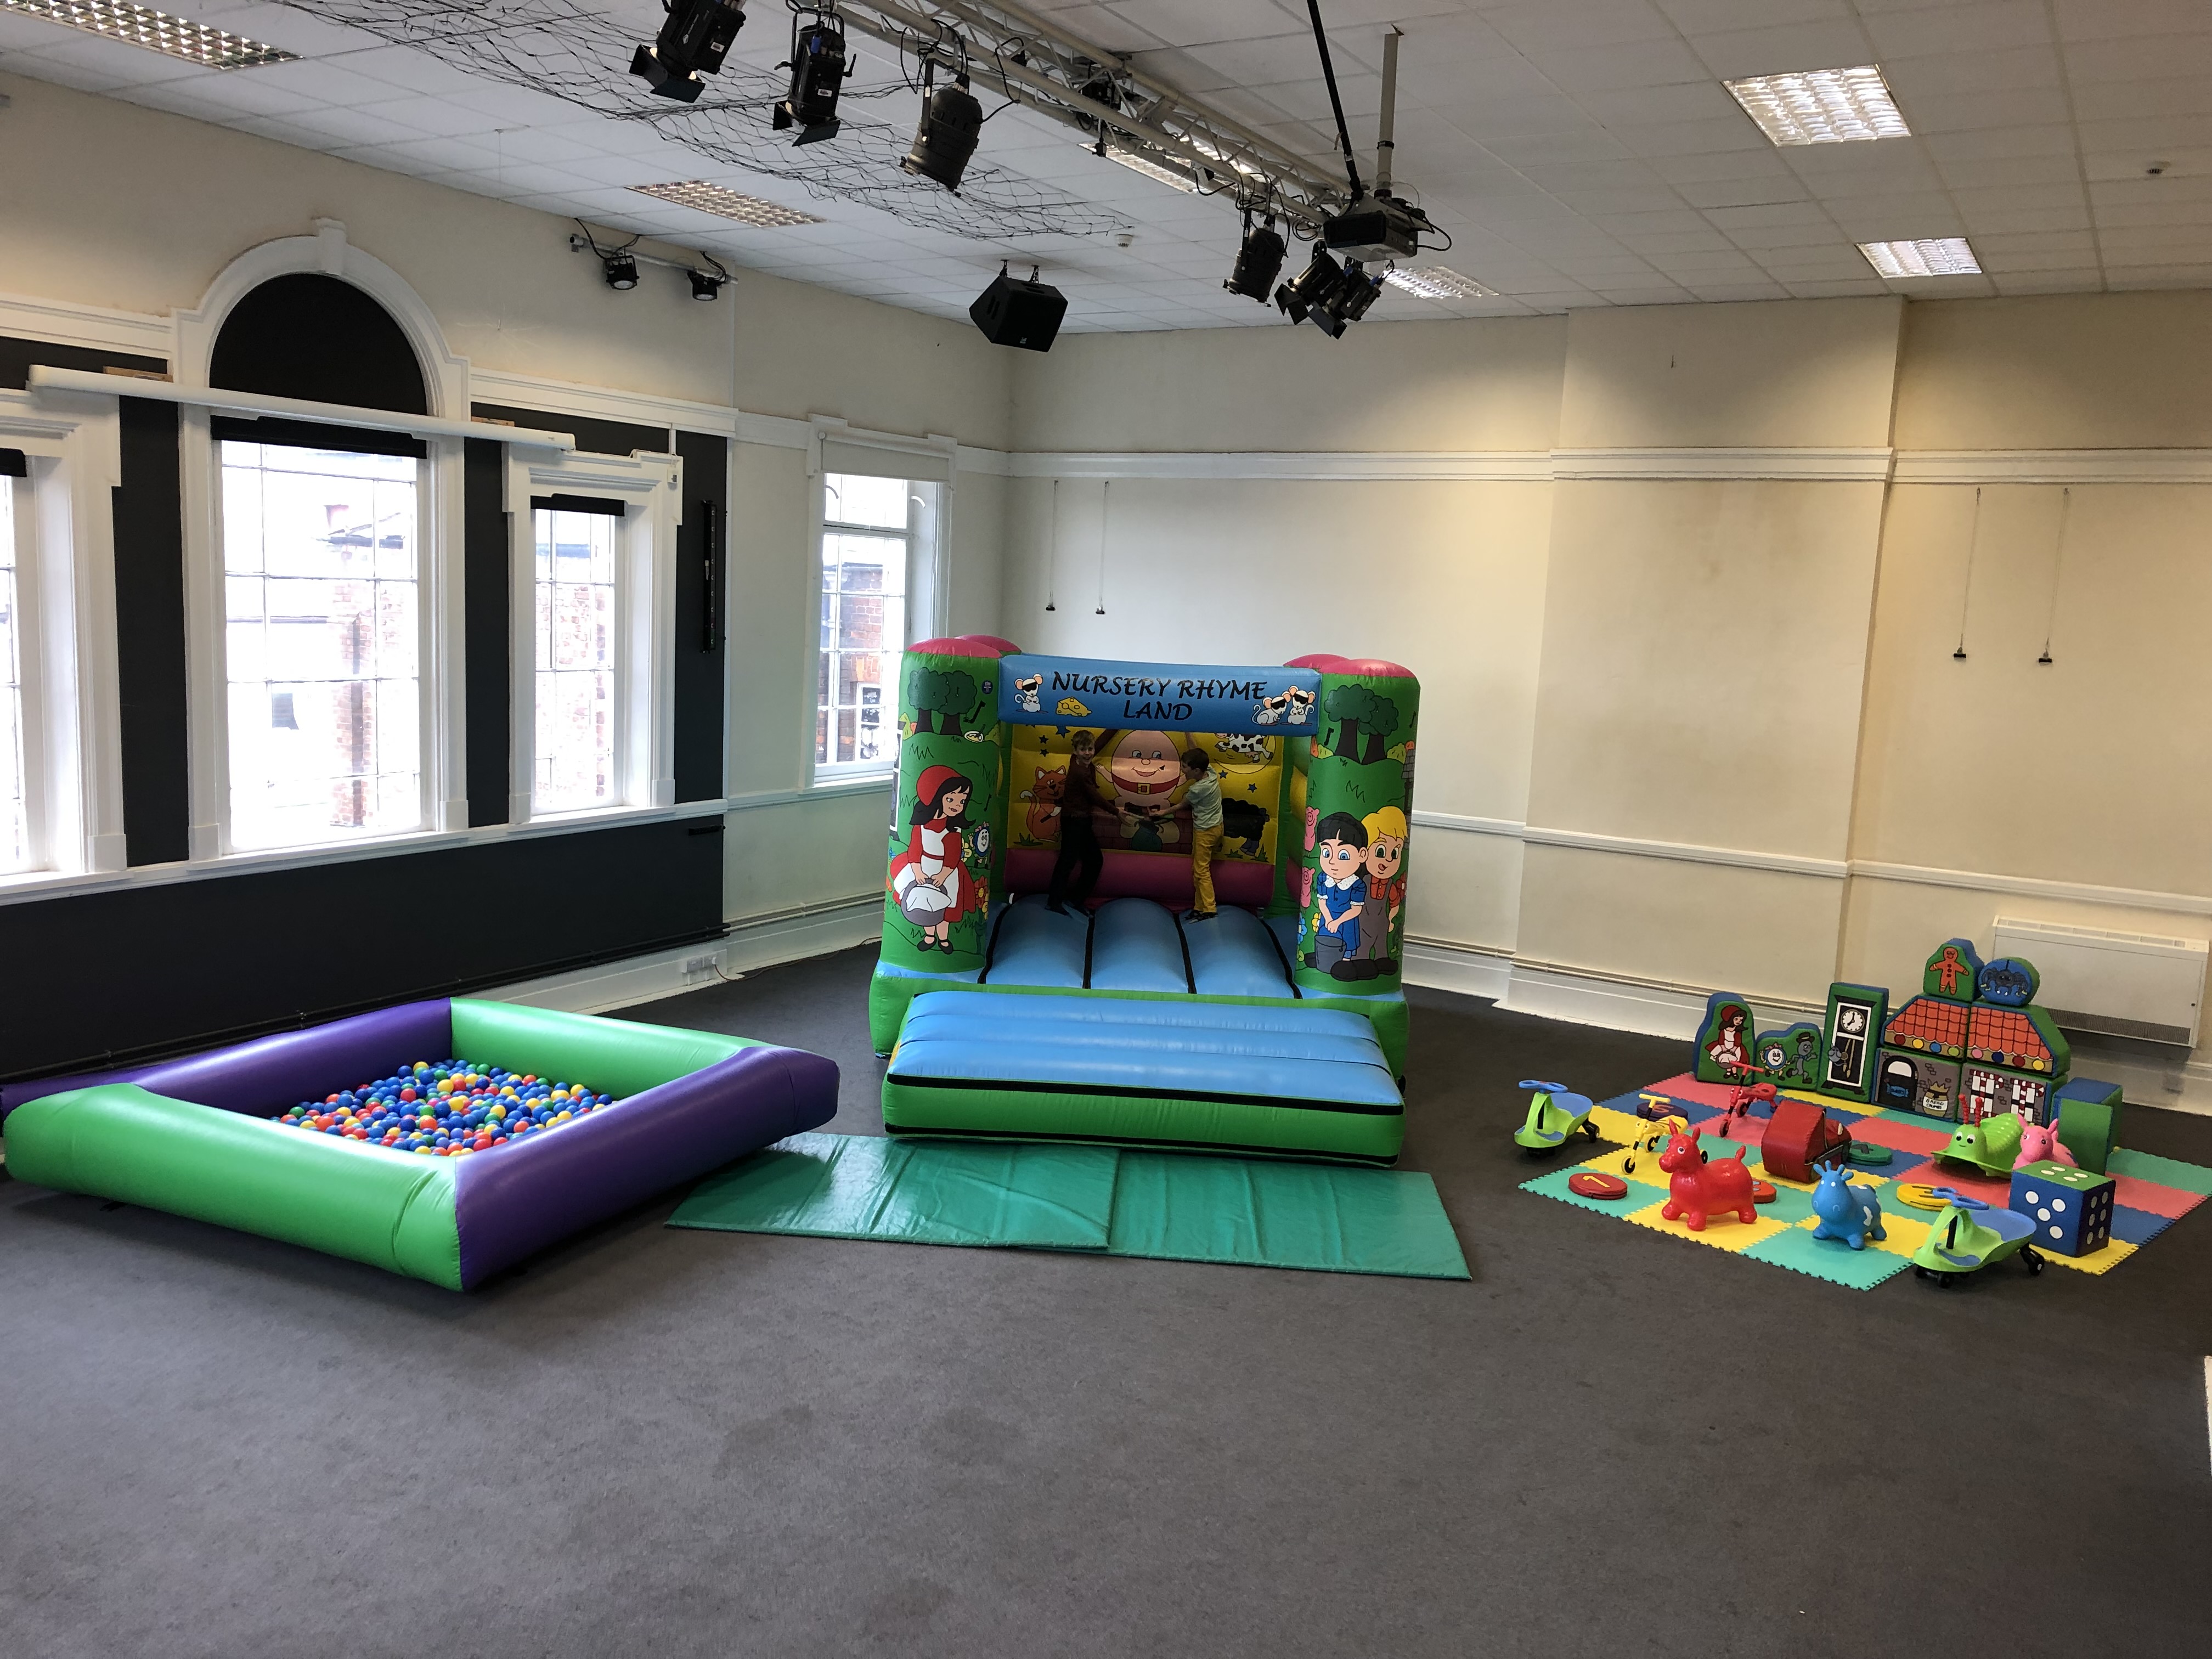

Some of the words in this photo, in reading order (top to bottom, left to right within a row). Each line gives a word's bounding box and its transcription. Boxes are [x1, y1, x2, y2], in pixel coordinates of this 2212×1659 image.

[1052, 671, 1171, 697] NURSERY
[1177, 679, 1268, 701] RHYME
[1123, 699, 1193, 720] LAND
[1582, 1175, 1611, 1188] 1
